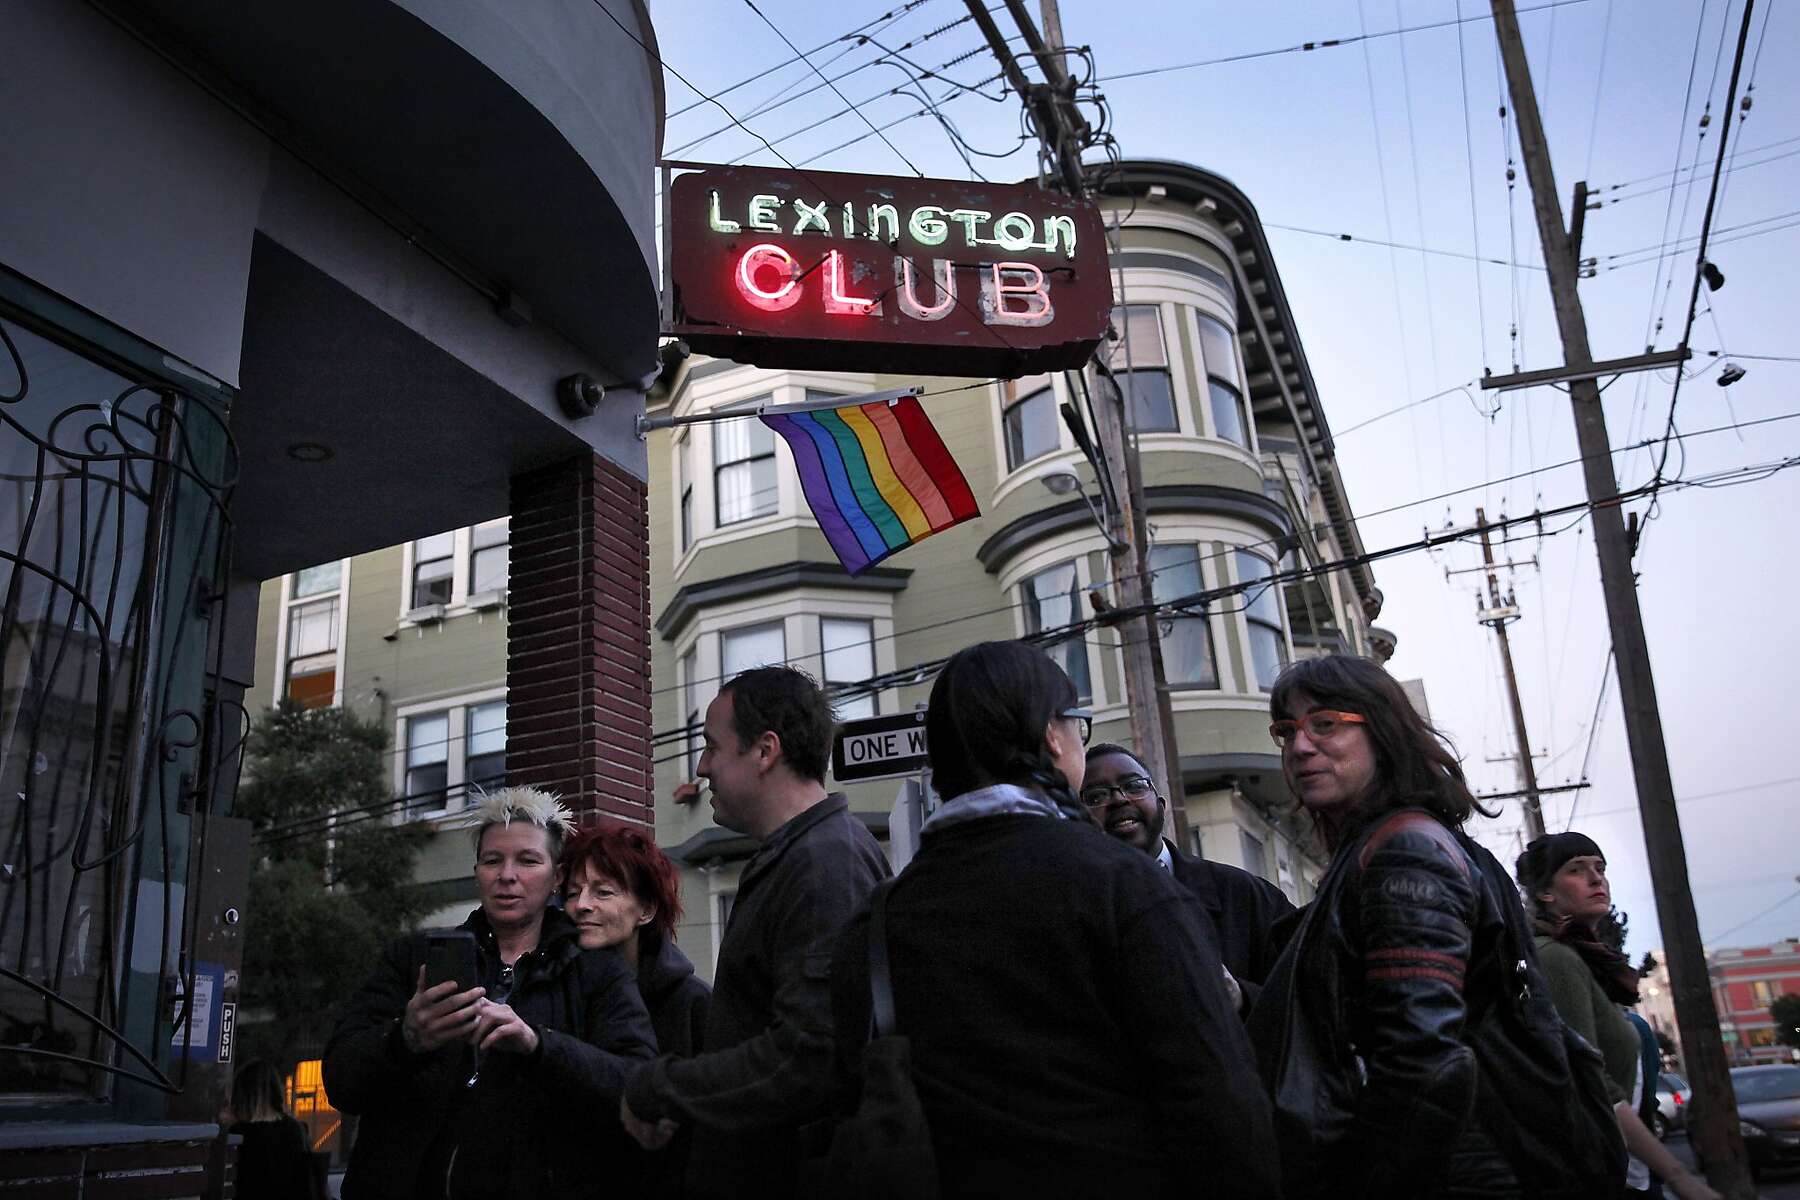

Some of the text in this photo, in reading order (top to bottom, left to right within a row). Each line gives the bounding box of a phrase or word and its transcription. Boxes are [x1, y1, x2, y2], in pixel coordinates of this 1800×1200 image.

[735, 244, 1056, 327] CLUB
[851, 730, 927, 762] ONE W
[221, 1009, 232, 1057] PUSH
